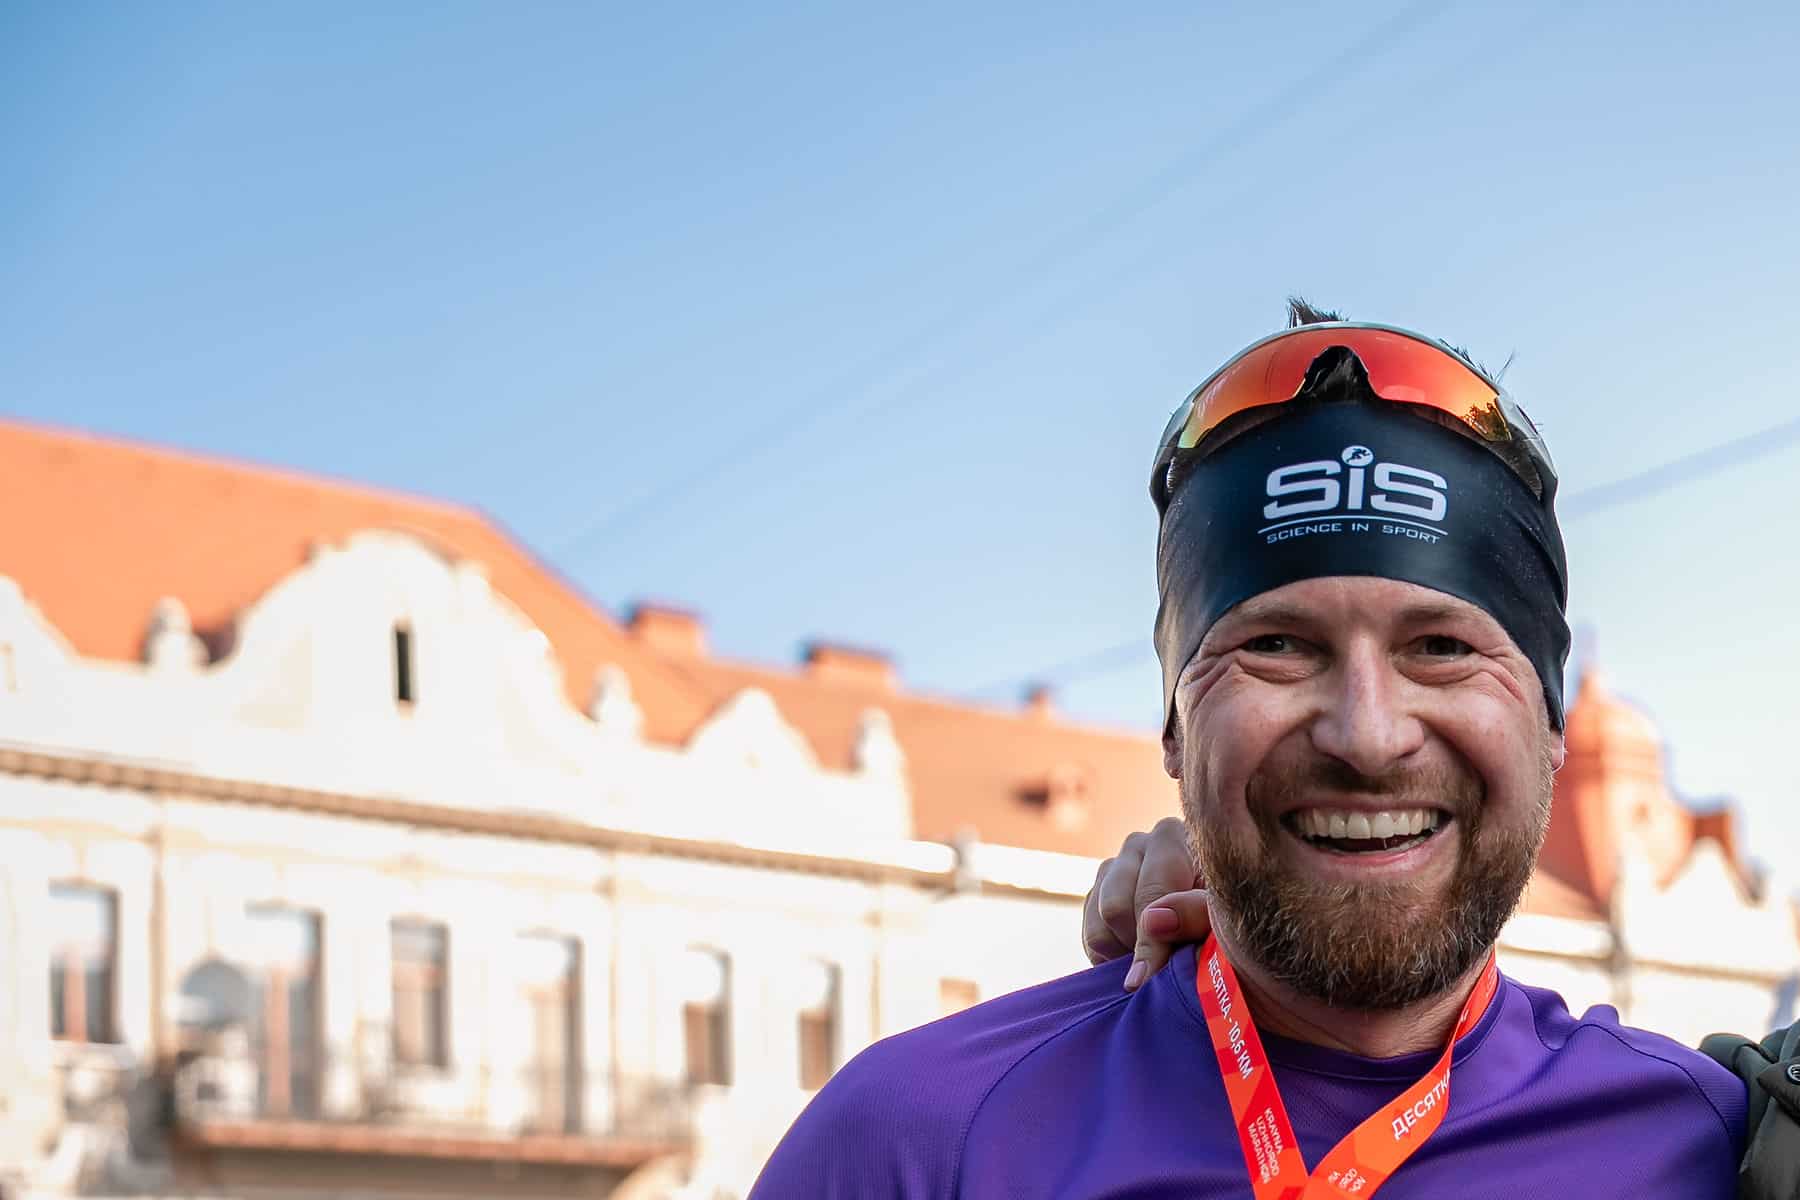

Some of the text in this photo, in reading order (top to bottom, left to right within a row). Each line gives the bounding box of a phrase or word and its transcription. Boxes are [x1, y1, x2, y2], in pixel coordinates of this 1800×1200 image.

[1266, 522, 1441, 545] SCIENCE IN SPORT
[1208, 952, 1232, 1019] ДЕСЯТКА
[1248, 1122, 1271, 1184] MARATHON
[1256, 1116, 1280, 1177] UZHHOROD
[1264, 1107, 1284, 1155] KRAYNA
